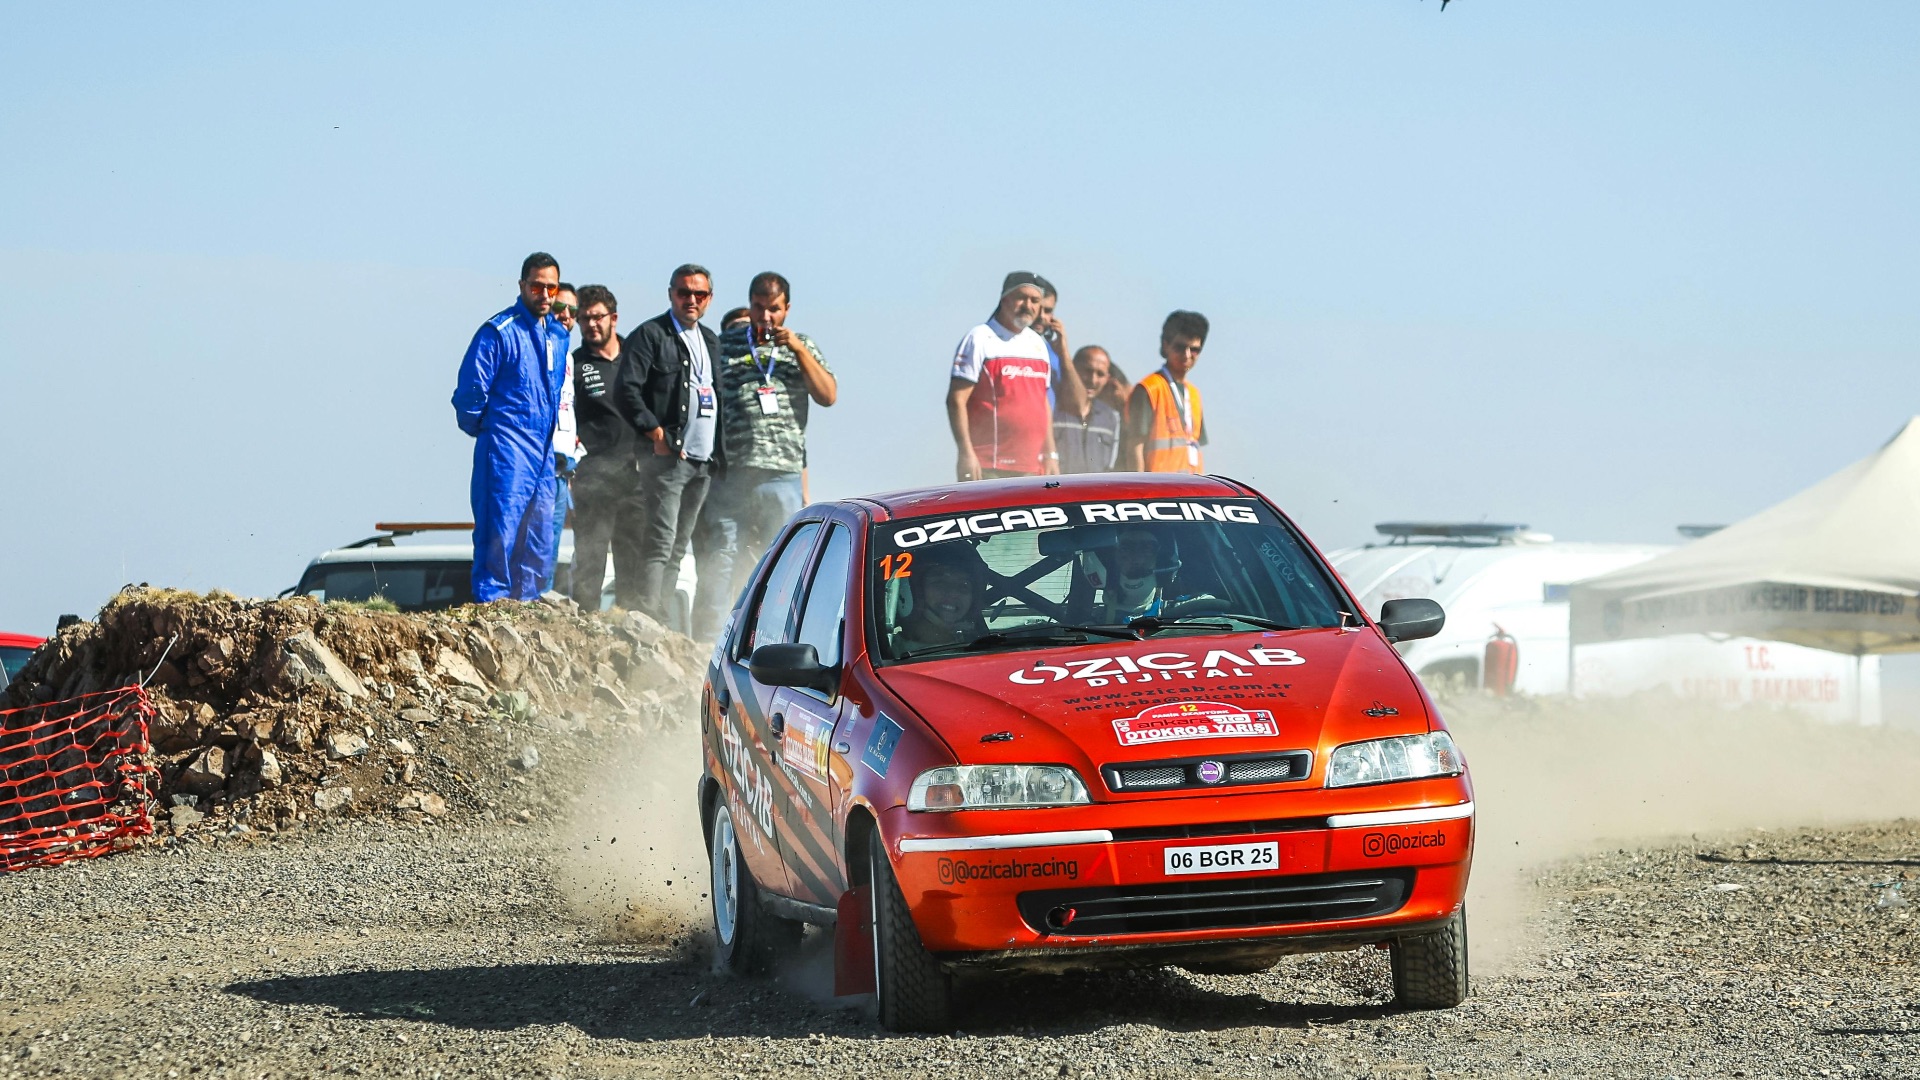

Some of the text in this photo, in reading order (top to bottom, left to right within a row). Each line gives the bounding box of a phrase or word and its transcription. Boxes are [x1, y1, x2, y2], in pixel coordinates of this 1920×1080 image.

[893, 502, 1259, 548] OZICAB RACING
[879, 552, 913, 581] 12
[1008, 648, 1306, 684] OZICAB
[1063, 683, 1292, 704] www.ozicab.com.tr
[1075, 691, 1287, 712] merhaba@ozicab.net
[1179, 704, 1198, 712] 12
[1125, 725, 1210, 740] OTOKROS
[1385, 829, 1446, 854] @ozicab
[1171, 847, 1273, 869] 06 BGR 25
[954, 856, 1079, 884] @ozicabracing
